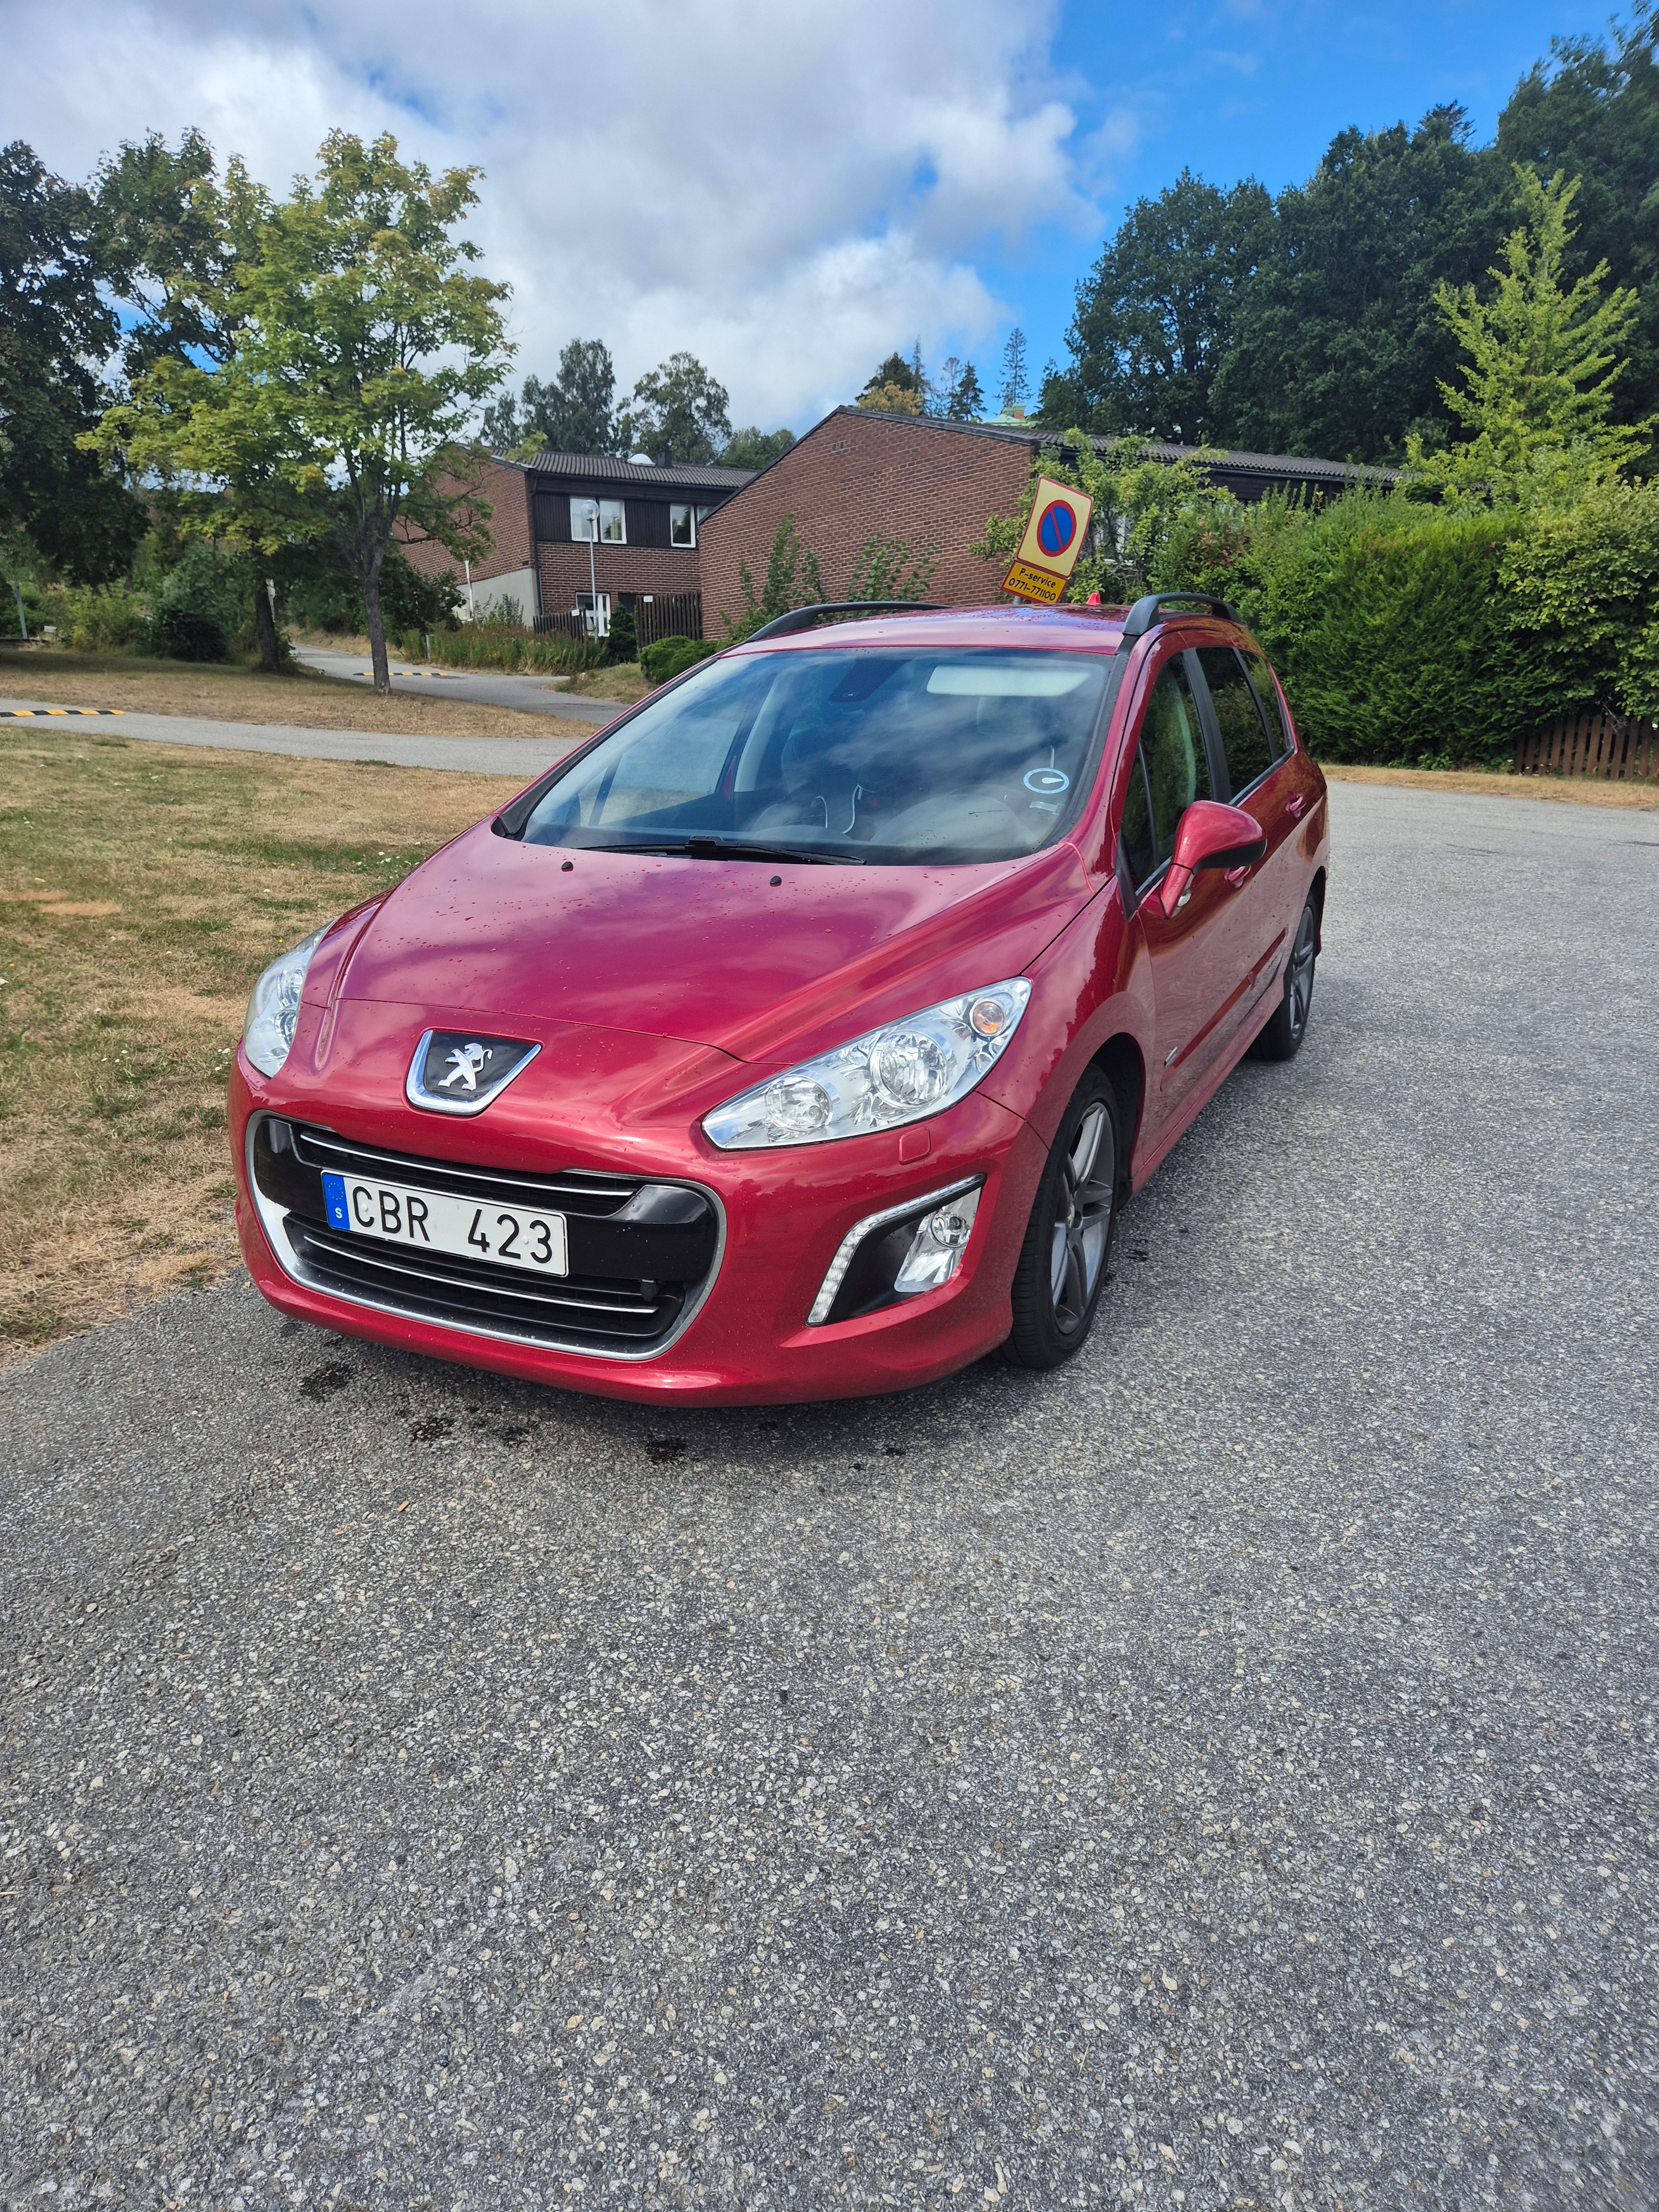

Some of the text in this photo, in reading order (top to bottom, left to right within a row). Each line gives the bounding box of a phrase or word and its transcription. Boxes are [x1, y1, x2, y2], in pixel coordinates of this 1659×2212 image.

[1019, 568, 1056, 588] P-service
[1009, 578, 1056, 601] 0771-771100
[335, 1207, 343, 1219] S
[352, 1186, 552, 1264] CBR 423
